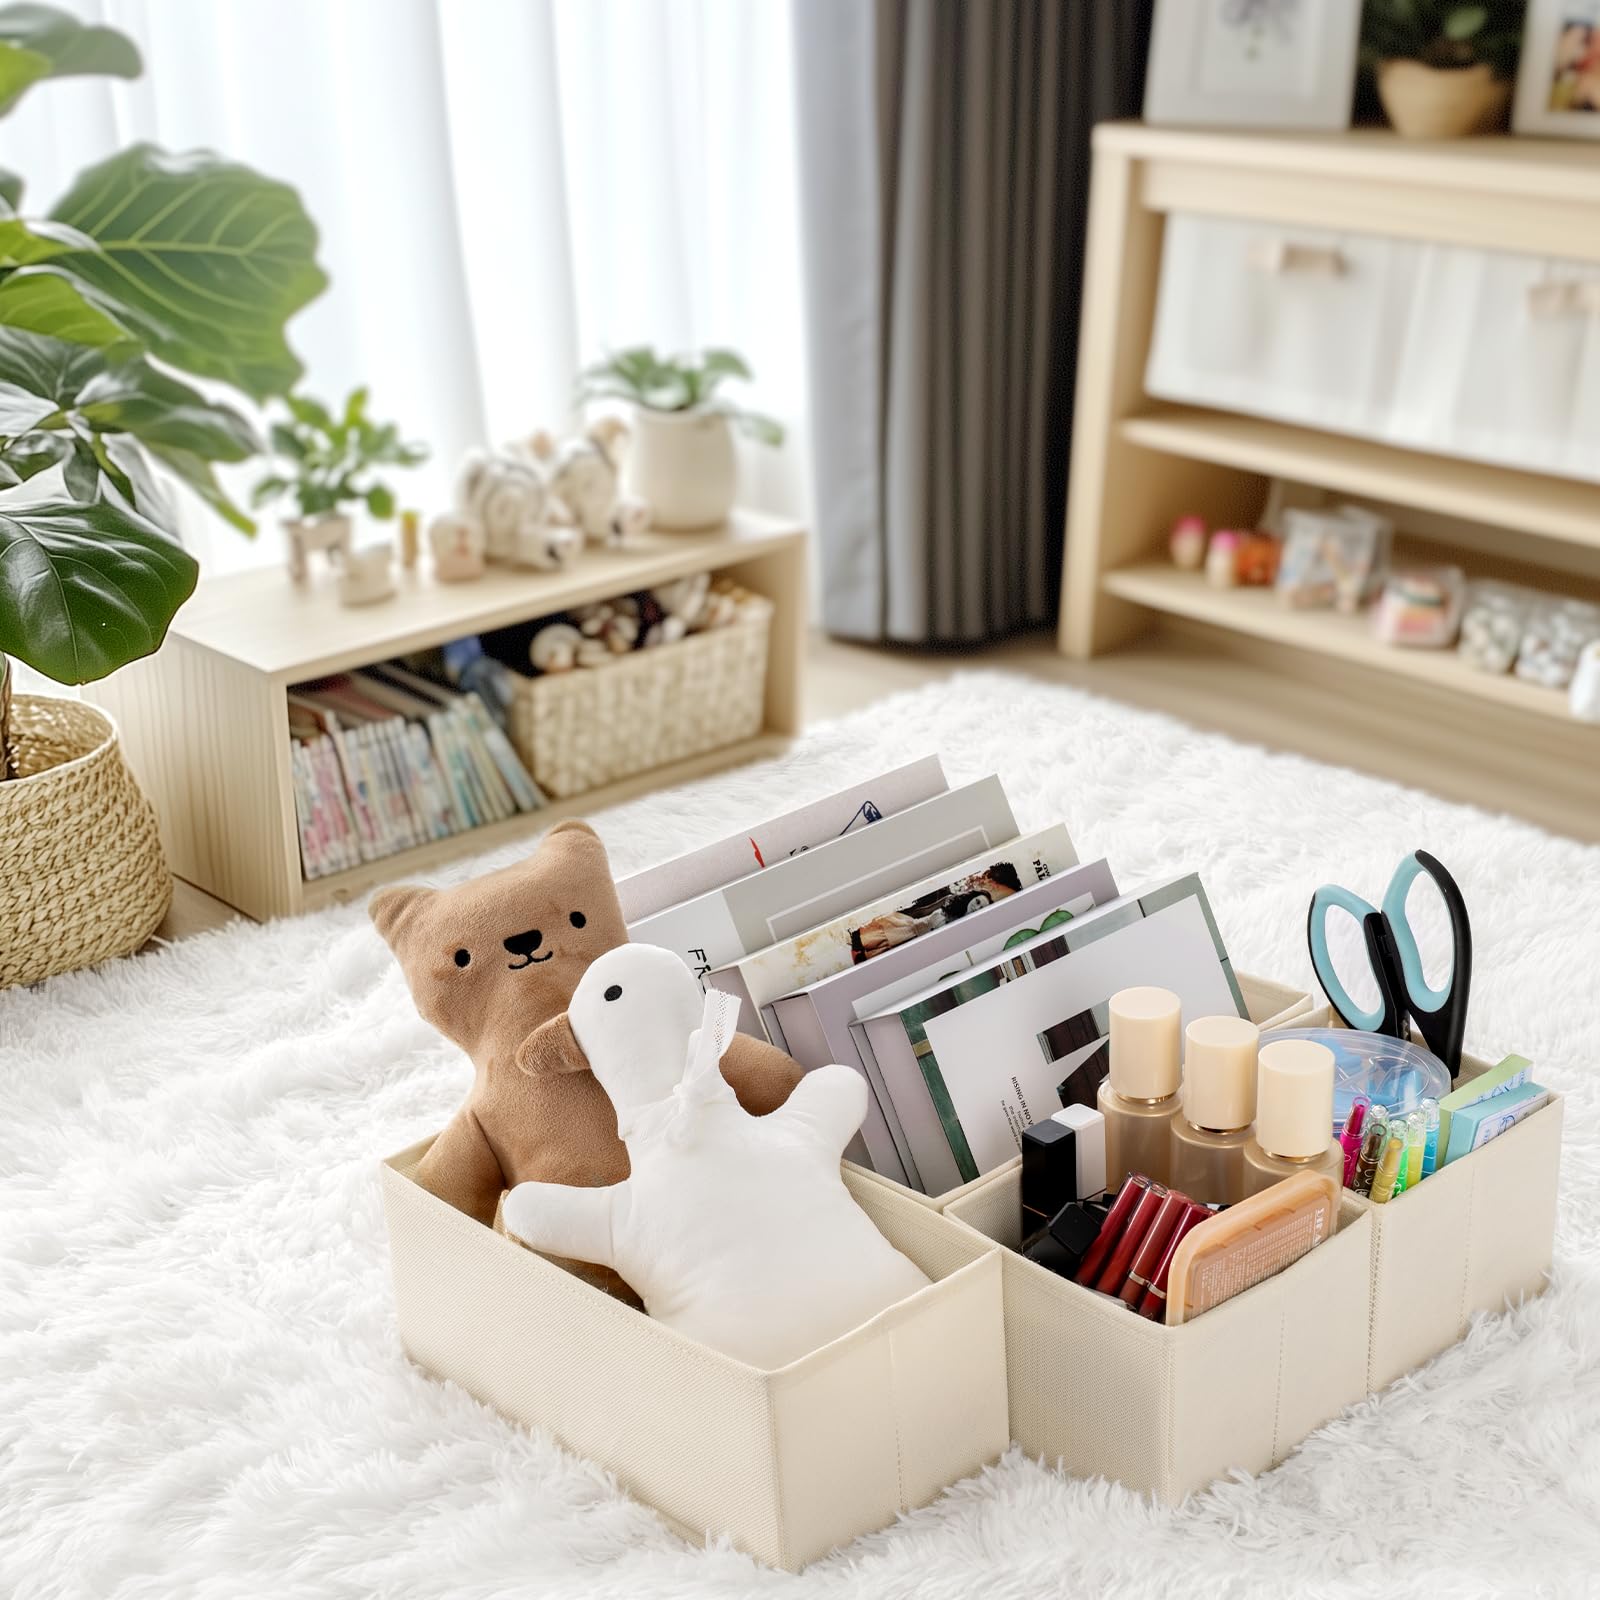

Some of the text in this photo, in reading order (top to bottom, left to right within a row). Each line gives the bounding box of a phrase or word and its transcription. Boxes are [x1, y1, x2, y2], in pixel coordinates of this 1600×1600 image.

[1011, 1076, 1024, 1101] RISING
[1020, 1100, 1027, 1109] IN
[1023, 1108, 1031, 1121] NO
